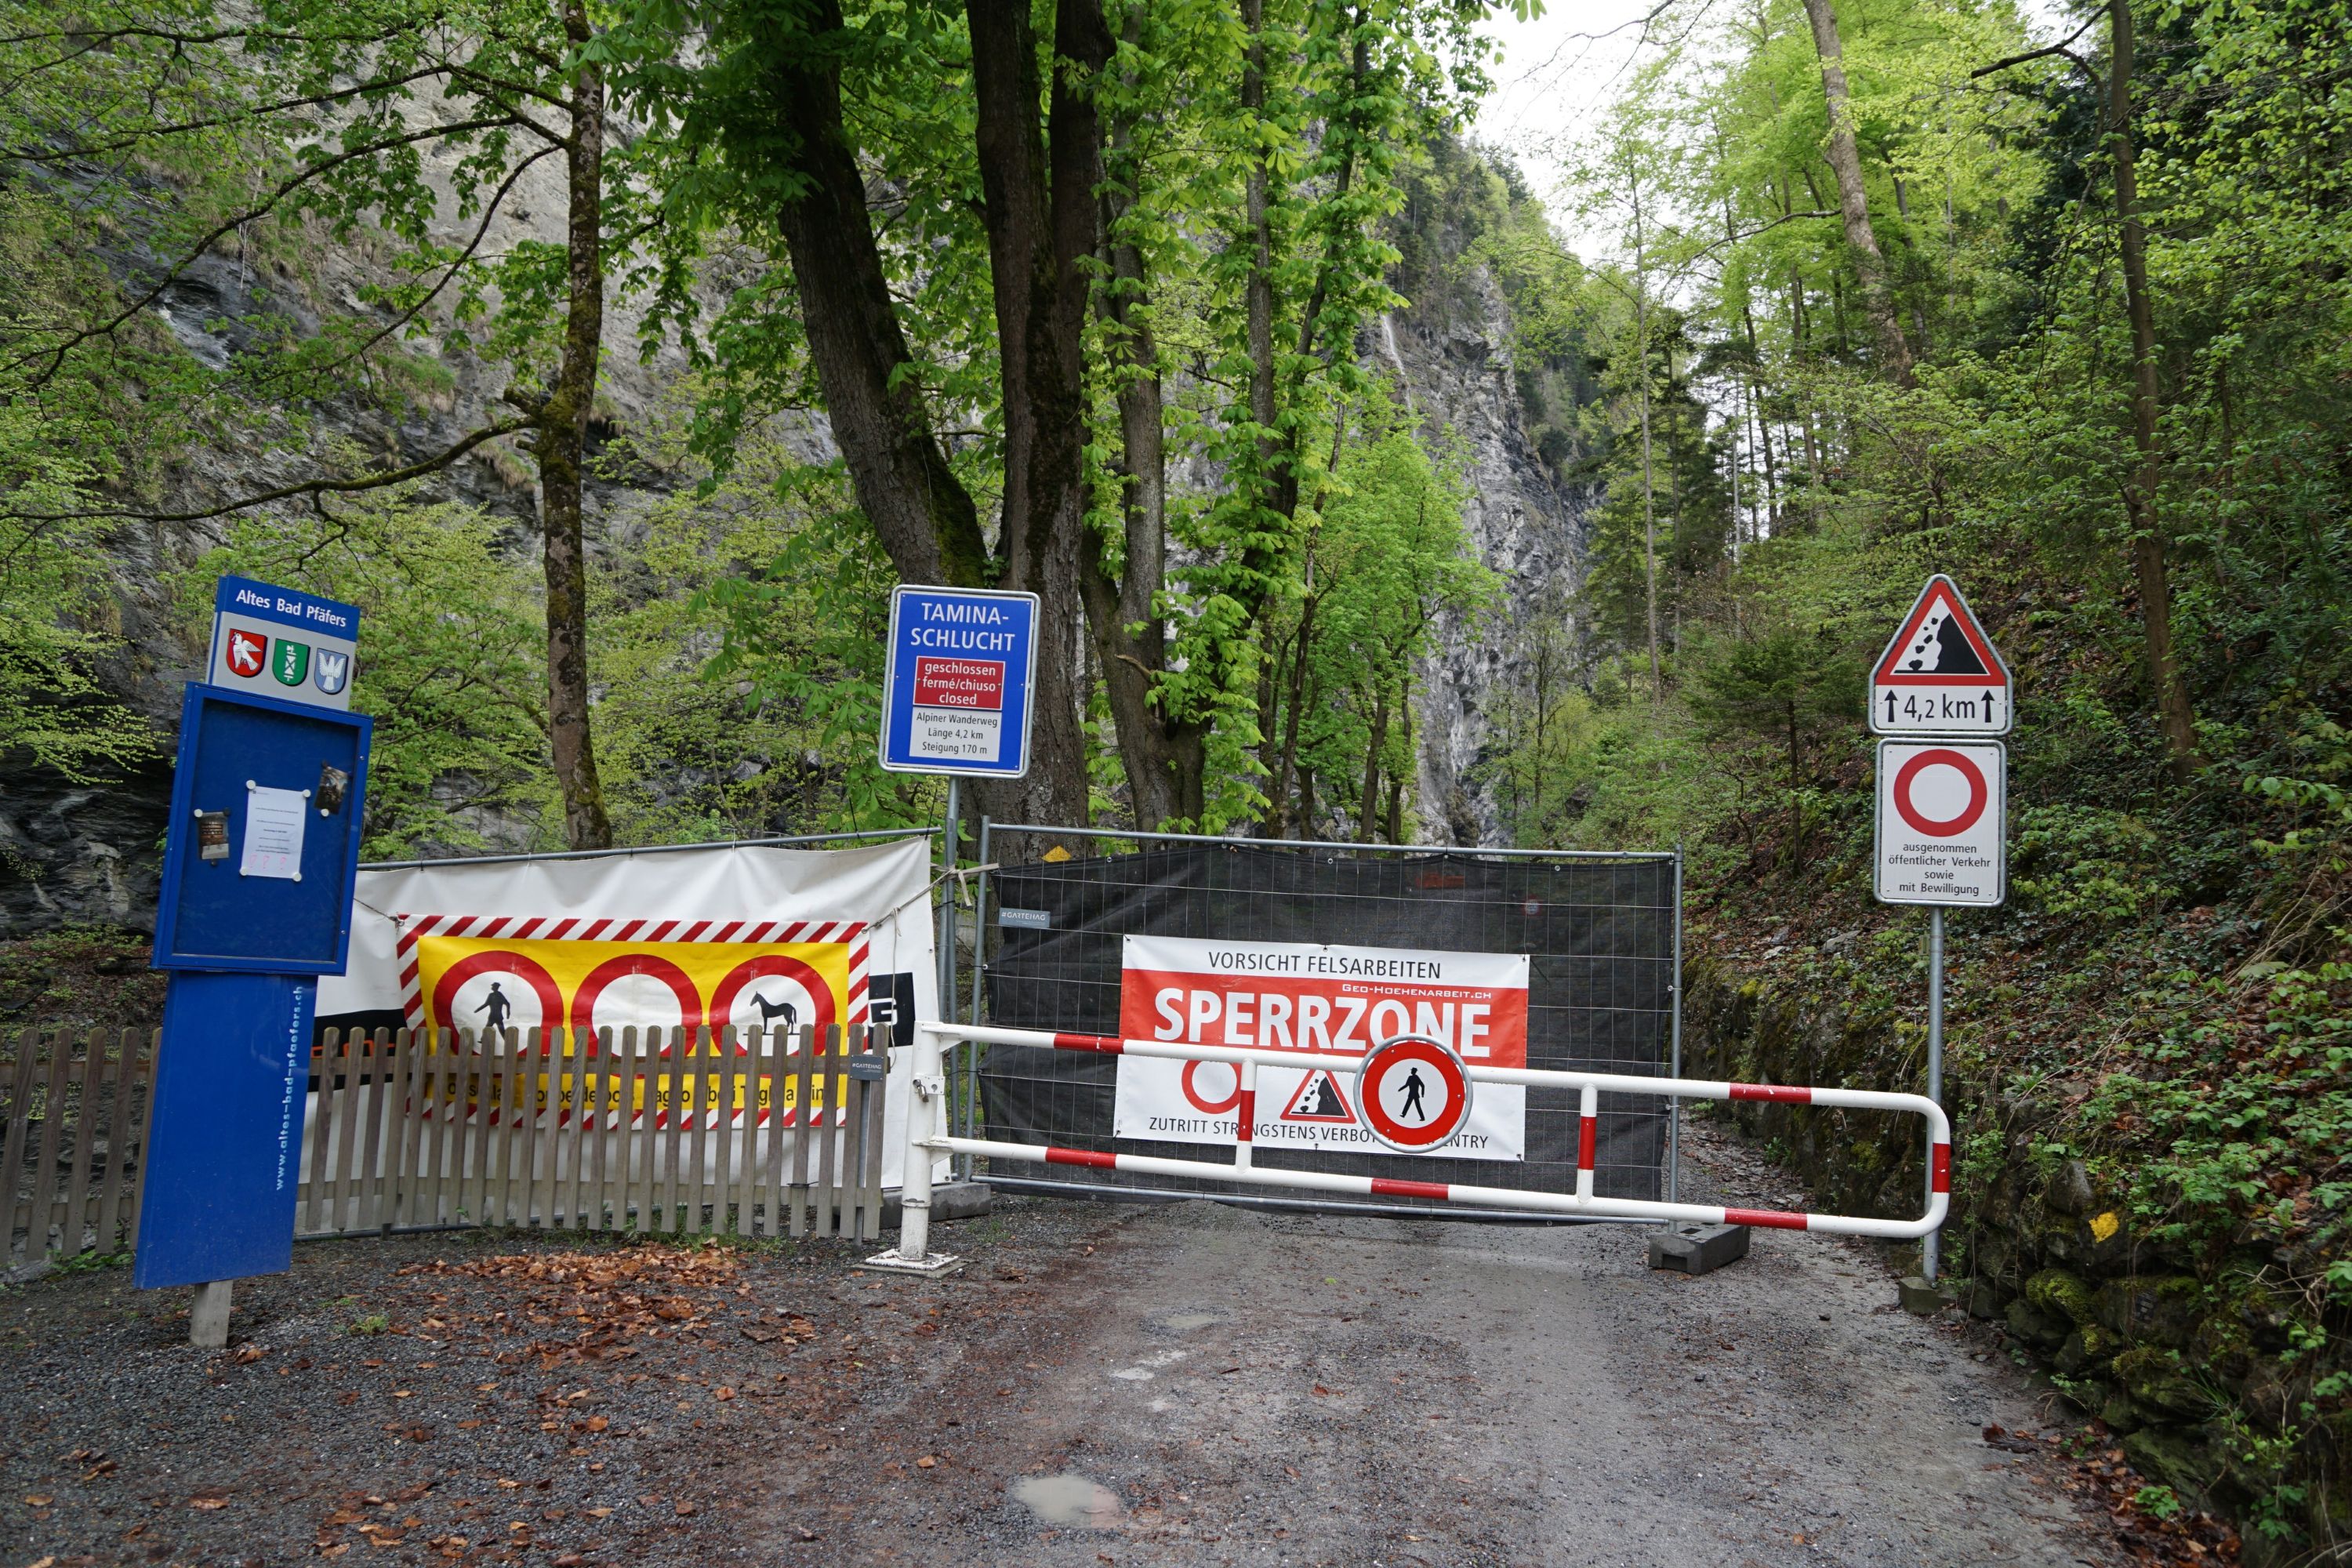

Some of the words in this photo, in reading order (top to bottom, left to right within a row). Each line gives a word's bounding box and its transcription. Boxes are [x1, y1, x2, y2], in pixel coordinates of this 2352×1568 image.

[236, 590, 270, 608] Altes
[277, 598, 302, 616] Bad
[306, 605, 347, 627] Pfäfers
[921, 602, 1009, 625] TAMINA-
[910, 628, 1015, 652] SCHLUCHT
[924, 662, 996, 677] geschlossen
[923, 677, 996, 692] fermé/chiuso
[938, 691, 977, 705] closed
[1904, 695, 1935, 724] 4,2
[1942, 693, 1976, 719] km
[916, 713, 947, 724] Alpiner
[949, 714, 998, 728] Wanderweg
[928, 728, 953, 739] Länge
[955, 729, 968, 739] 4,2
[971, 729, 983, 739] km
[922, 742, 959, 754] Steigung
[962, 744, 977, 753] 170
[1903, 843, 1976, 855] ausgenommen
[1889, 854, 1947, 866] öffentlicher
[1951, 855, 1991, 868] Verkehr
[1924, 869, 1954, 880] sowie
[1899, 881, 1915, 892] mit
[1921, 883, 1979, 896] Bewilligung
[1208, 951, 1299, 972] VORSICHT
[1308, 956, 1441, 979] FELSARBEITEN
[1154, 988, 1491, 1058] SPERRZONE
[276, 985, 303, 1191] www.altes-bad-pfaefers.ch
[1149, 1117, 1207, 1134] ZUTRITT
[1213, 1121, 1316, 1140] STRNGSTENS
[1321, 1127, 1398, 1144] VERBO
[1443, 1134, 1489, 1149] NTRY
